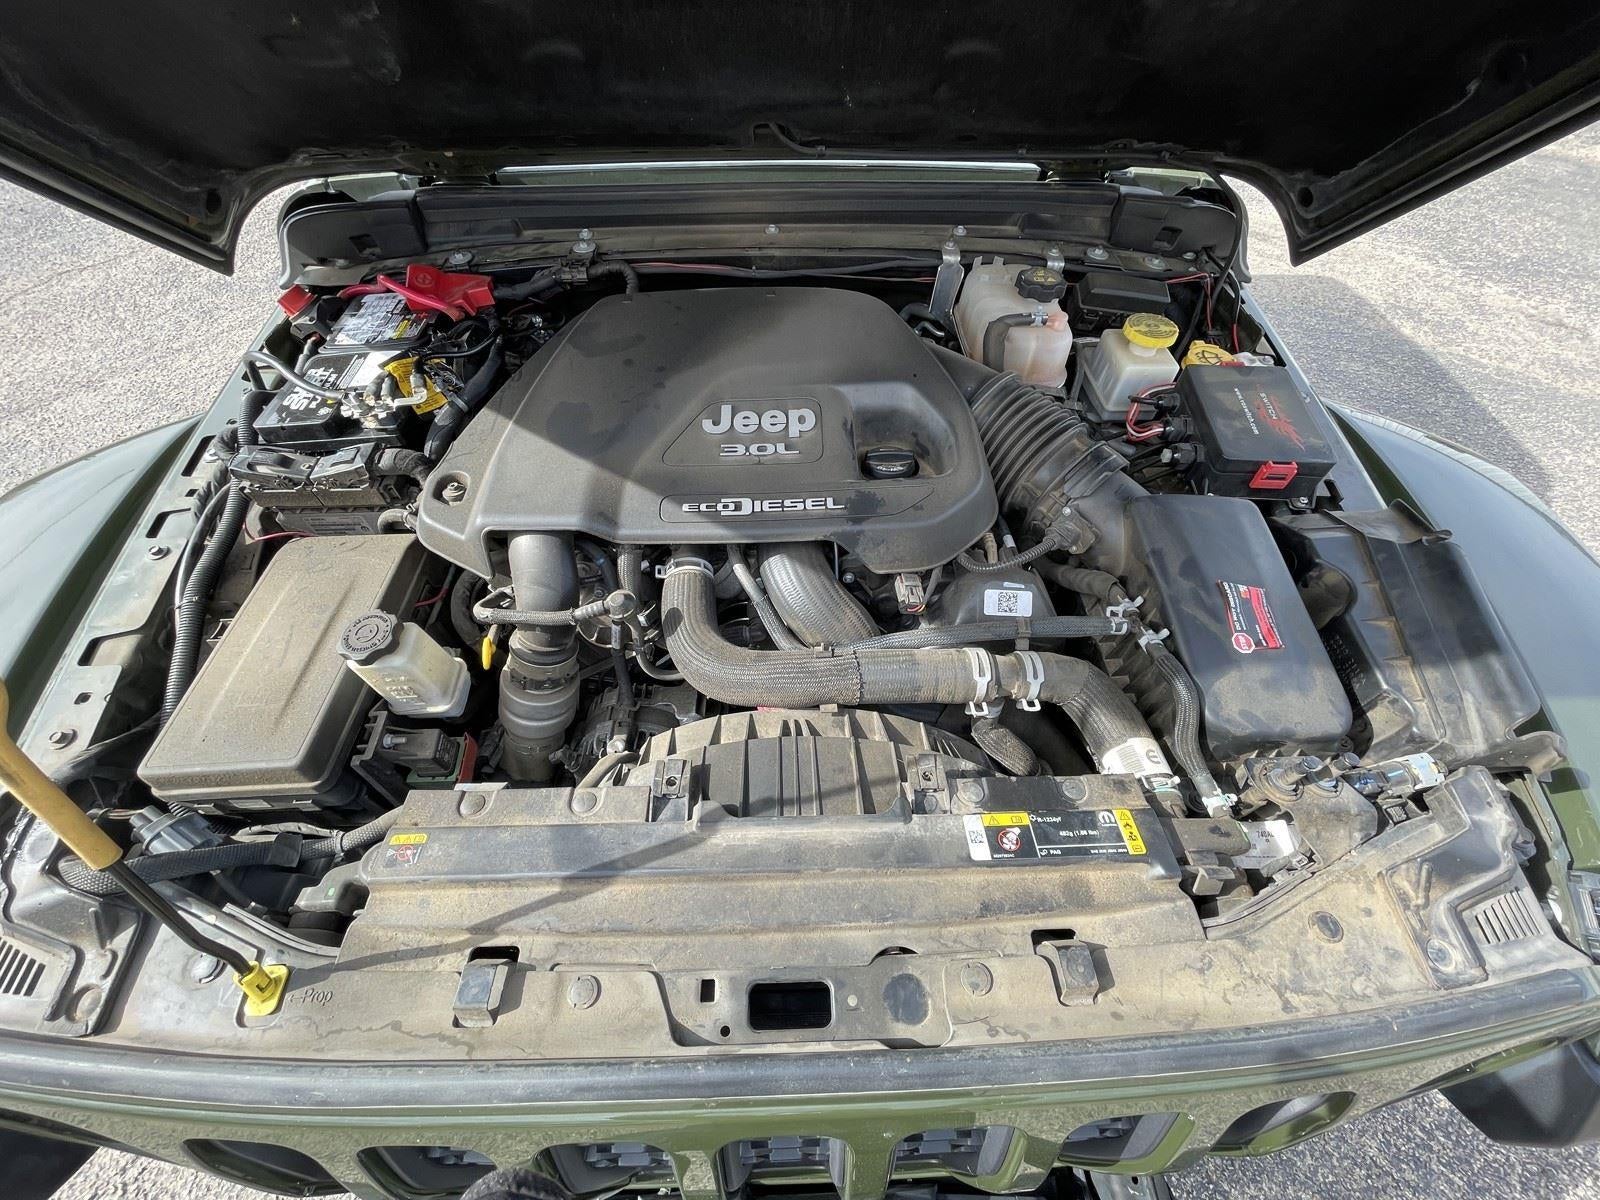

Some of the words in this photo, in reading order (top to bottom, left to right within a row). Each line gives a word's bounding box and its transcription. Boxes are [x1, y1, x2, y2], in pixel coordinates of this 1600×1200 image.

[1260, 392, 1278, 419] SWITCH
[702, 404, 816, 437] Jeep
[719, 442, 800, 456] 3.0L
[1223, 582, 1234, 608] DISCARD
[1234, 621, 1241, 630] DO
[1238, 635, 1249, 650] STOP
[302, 987, 333, 1007] Prop
